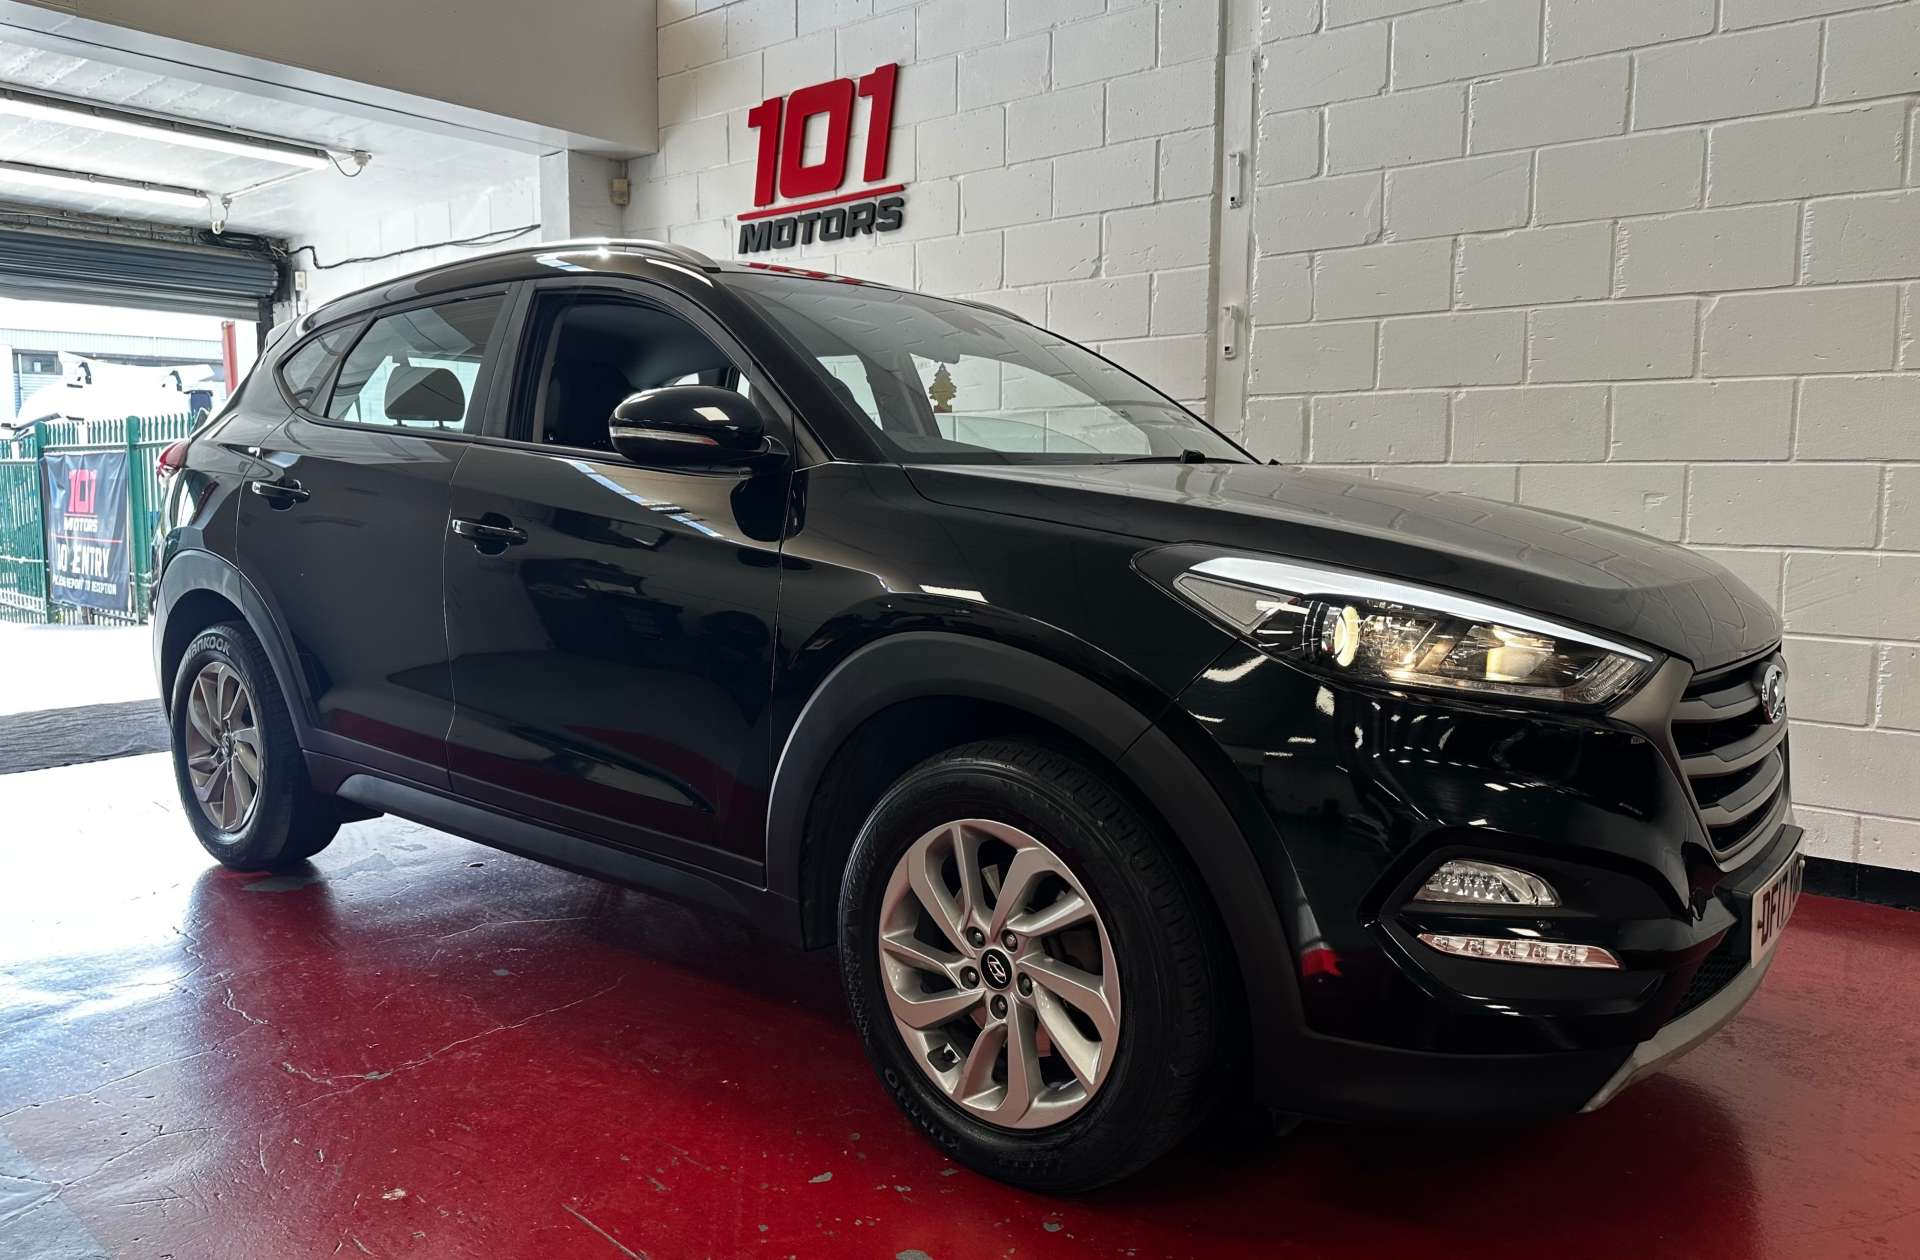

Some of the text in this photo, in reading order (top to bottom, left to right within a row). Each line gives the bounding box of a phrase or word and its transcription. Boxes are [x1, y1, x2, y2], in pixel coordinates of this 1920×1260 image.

[748, 62, 899, 208] 101
[738, 196, 905, 255] MOTORS
[68, 468, 97, 513] 101
[63, 516, 98, 532] MOTORS
[71, 544, 111, 578] ENTRY
